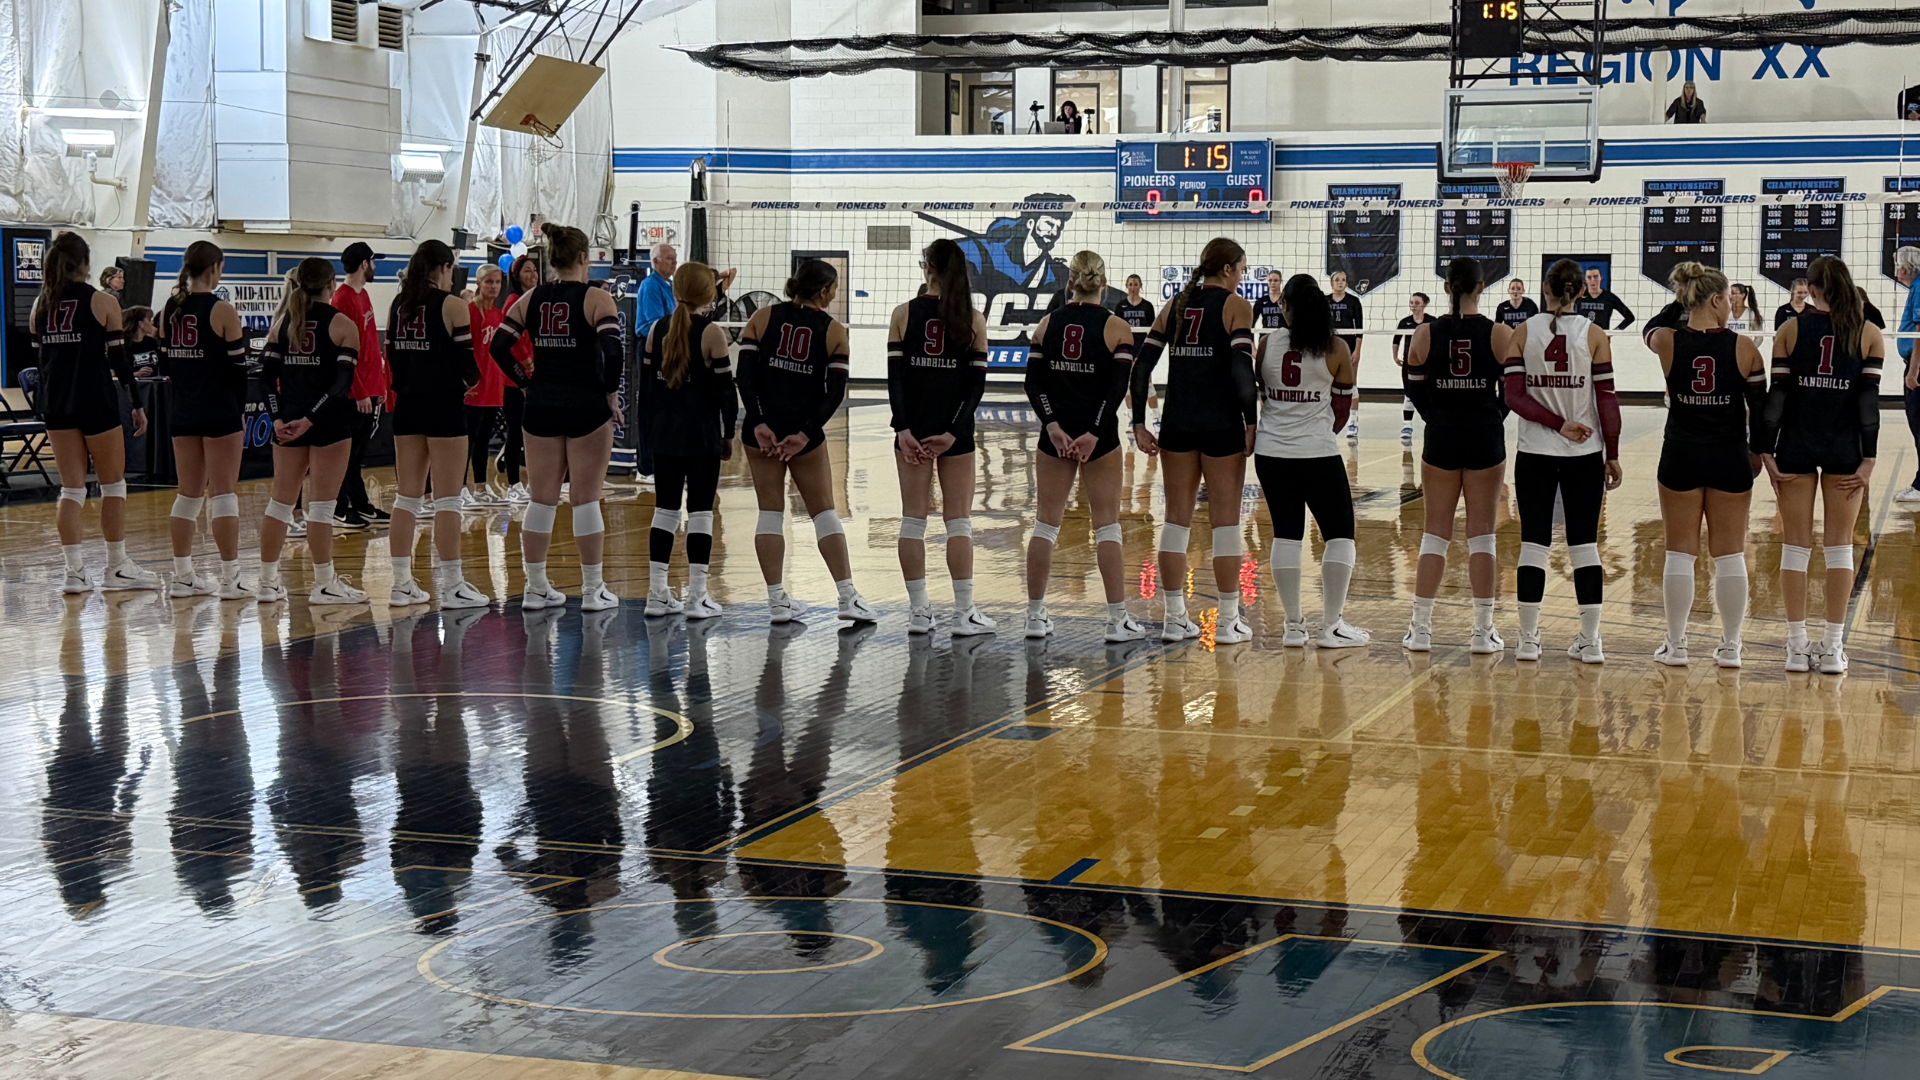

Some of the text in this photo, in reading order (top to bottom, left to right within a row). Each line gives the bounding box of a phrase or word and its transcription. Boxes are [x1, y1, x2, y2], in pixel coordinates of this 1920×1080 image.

[1482, 1, 1518, 20] 1:15
[1509, 42, 1830, 86] REGION XX
[1184, 144, 1228, 169] 1:15
[1124, 174, 1176, 187] PIONEERS
[1180, 181, 1206, 190] PERIOD
[1226, 174, 1262, 186] GUEST
[1648, 182, 1718, 190] CHAMPIONSHIPS
[1766, 181, 1840, 189] CHAMPIONSHIPS
[1487, 198, 1545, 206] PIONEERS
[1588, 196, 1649, 206] PIONEERS
[1694, 194, 1756, 204] PIONEERS
[1802, 192, 1866, 202] PIONEERS
[836, 202, 887, 210] PIONEERS
[924, 202, 974, 210] PIONEERS
[1012, 202, 1064, 210] PIONEERS
[1103, 202, 1156, 210] PIONEERS
[1196, 201, 1249, 209] PIONEERS
[1290, 200, 1345, 209] PIONEERS
[1387, 200, 1444, 208] PIONEERS
[46, 300, 78, 333] 17
[396, 305, 426, 339] 14
[540, 302, 569, 336] 12
[170, 314, 198, 347] 16
[1184, 308, 1204, 344] 7
[42, 333, 82, 344] SANDHILLS
[288, 320, 318, 355] 5
[534, 338, 576, 347] SANDHILLS
[776, 322, 812, 361] 10
[924, 318, 945, 355] 9
[1062, 324, 1084, 360] 8
[167, 349, 204, 358] SANDHILLS
[1170, 346, 1213, 356] SANDHILLS
[1544, 334, 1568, 372] 4
[1818, 335, 1835, 375] 1
[910, 356, 957, 368] SANDHILLS
[1450, 340, 1471, 377] 5
[769, 357, 813, 374] SANDHILLS
[1050, 360, 1095, 373] SANDHILLS
[1281, 350, 1302, 387] 6
[1692, 356, 1715, 394] 3
[1436, 379, 1487, 388] SANDHILLS
[1527, 375, 1585, 388] SANDHILLS
[1798, 376, 1850, 390] SANDHILLS
[1677, 394, 1730, 405] SANDHILLS
